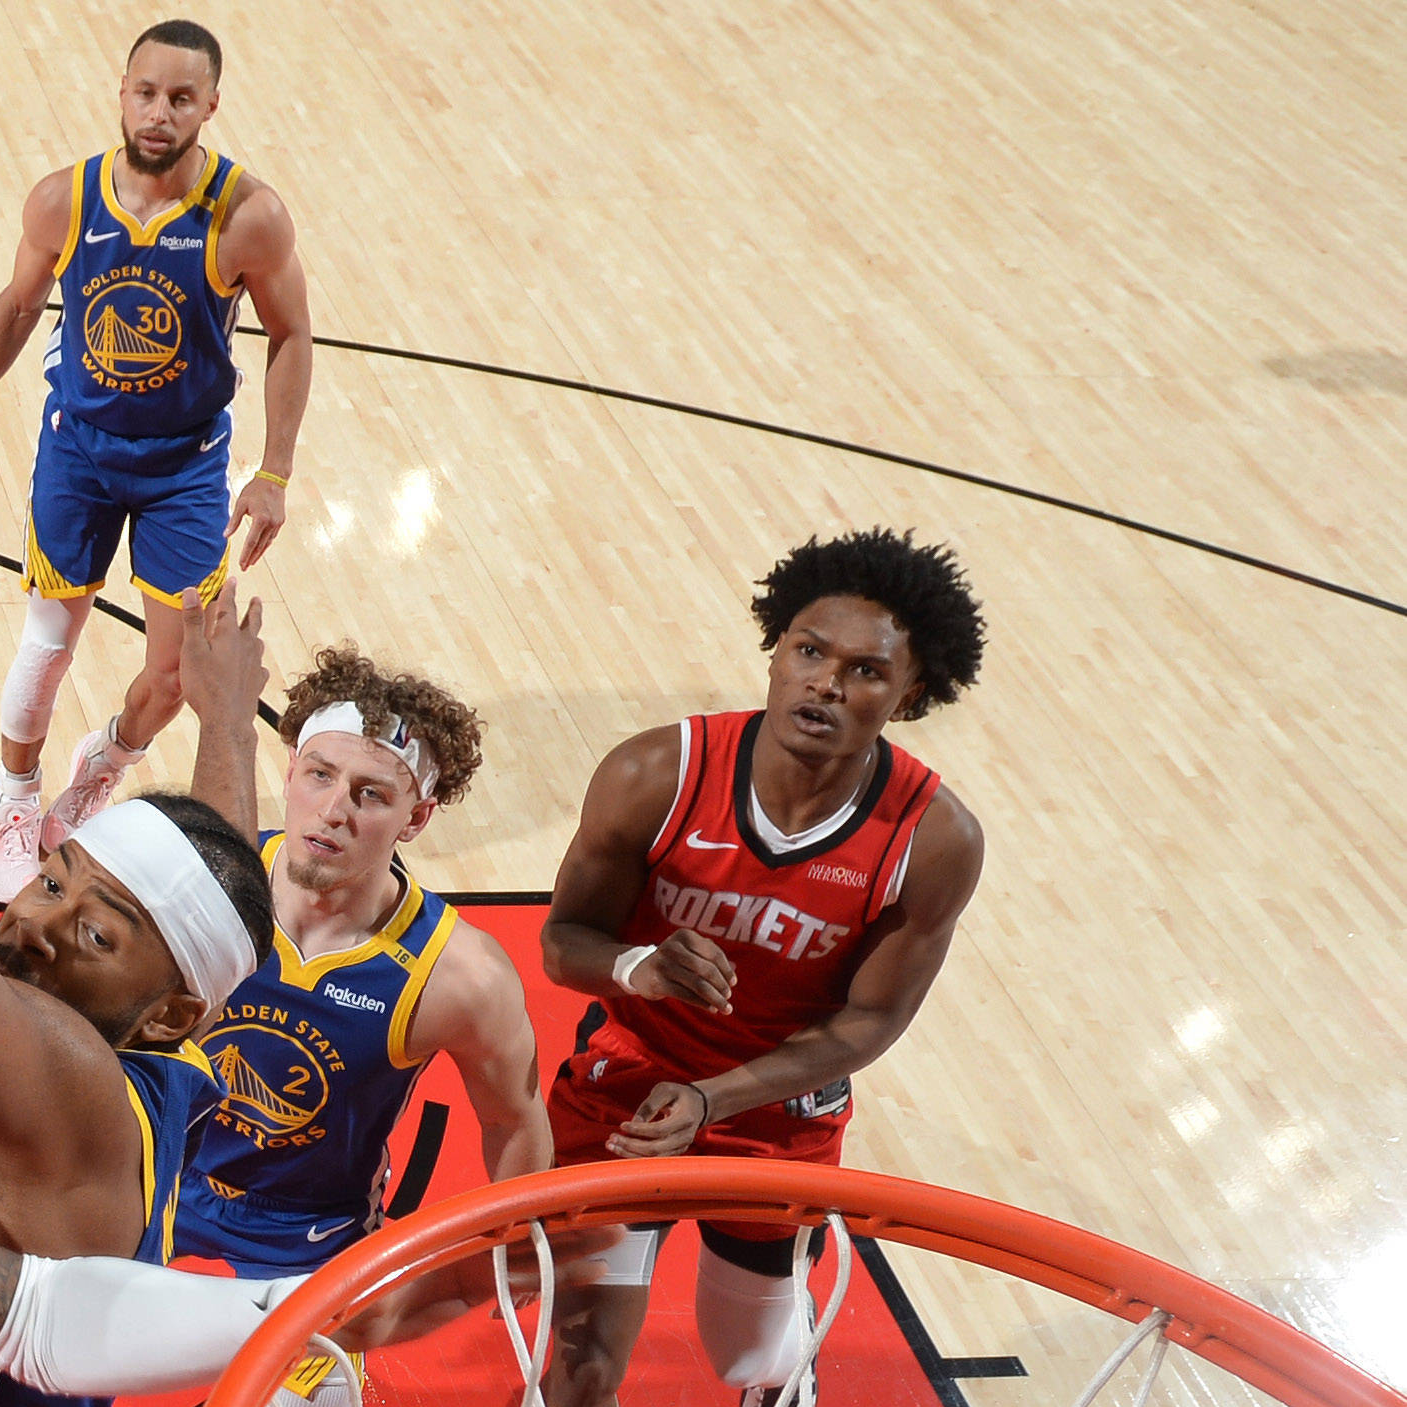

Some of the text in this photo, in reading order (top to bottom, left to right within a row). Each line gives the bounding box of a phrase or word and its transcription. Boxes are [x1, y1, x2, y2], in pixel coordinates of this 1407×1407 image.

[159, 235, 204, 250] Rakuten
[82, 265, 187, 304] GOLDEN STATE
[136, 304, 172, 334] 30
[81, 351, 189, 393] WARRIORS
[653, 875, 851, 961] ROCKETS
[323, 982, 386, 1014] Rakuten
[216, 1004, 346, 1073] LDEN STATE
[282, 1065, 311, 1096] 2
[214, 1112, 327, 1151] RRIORS
